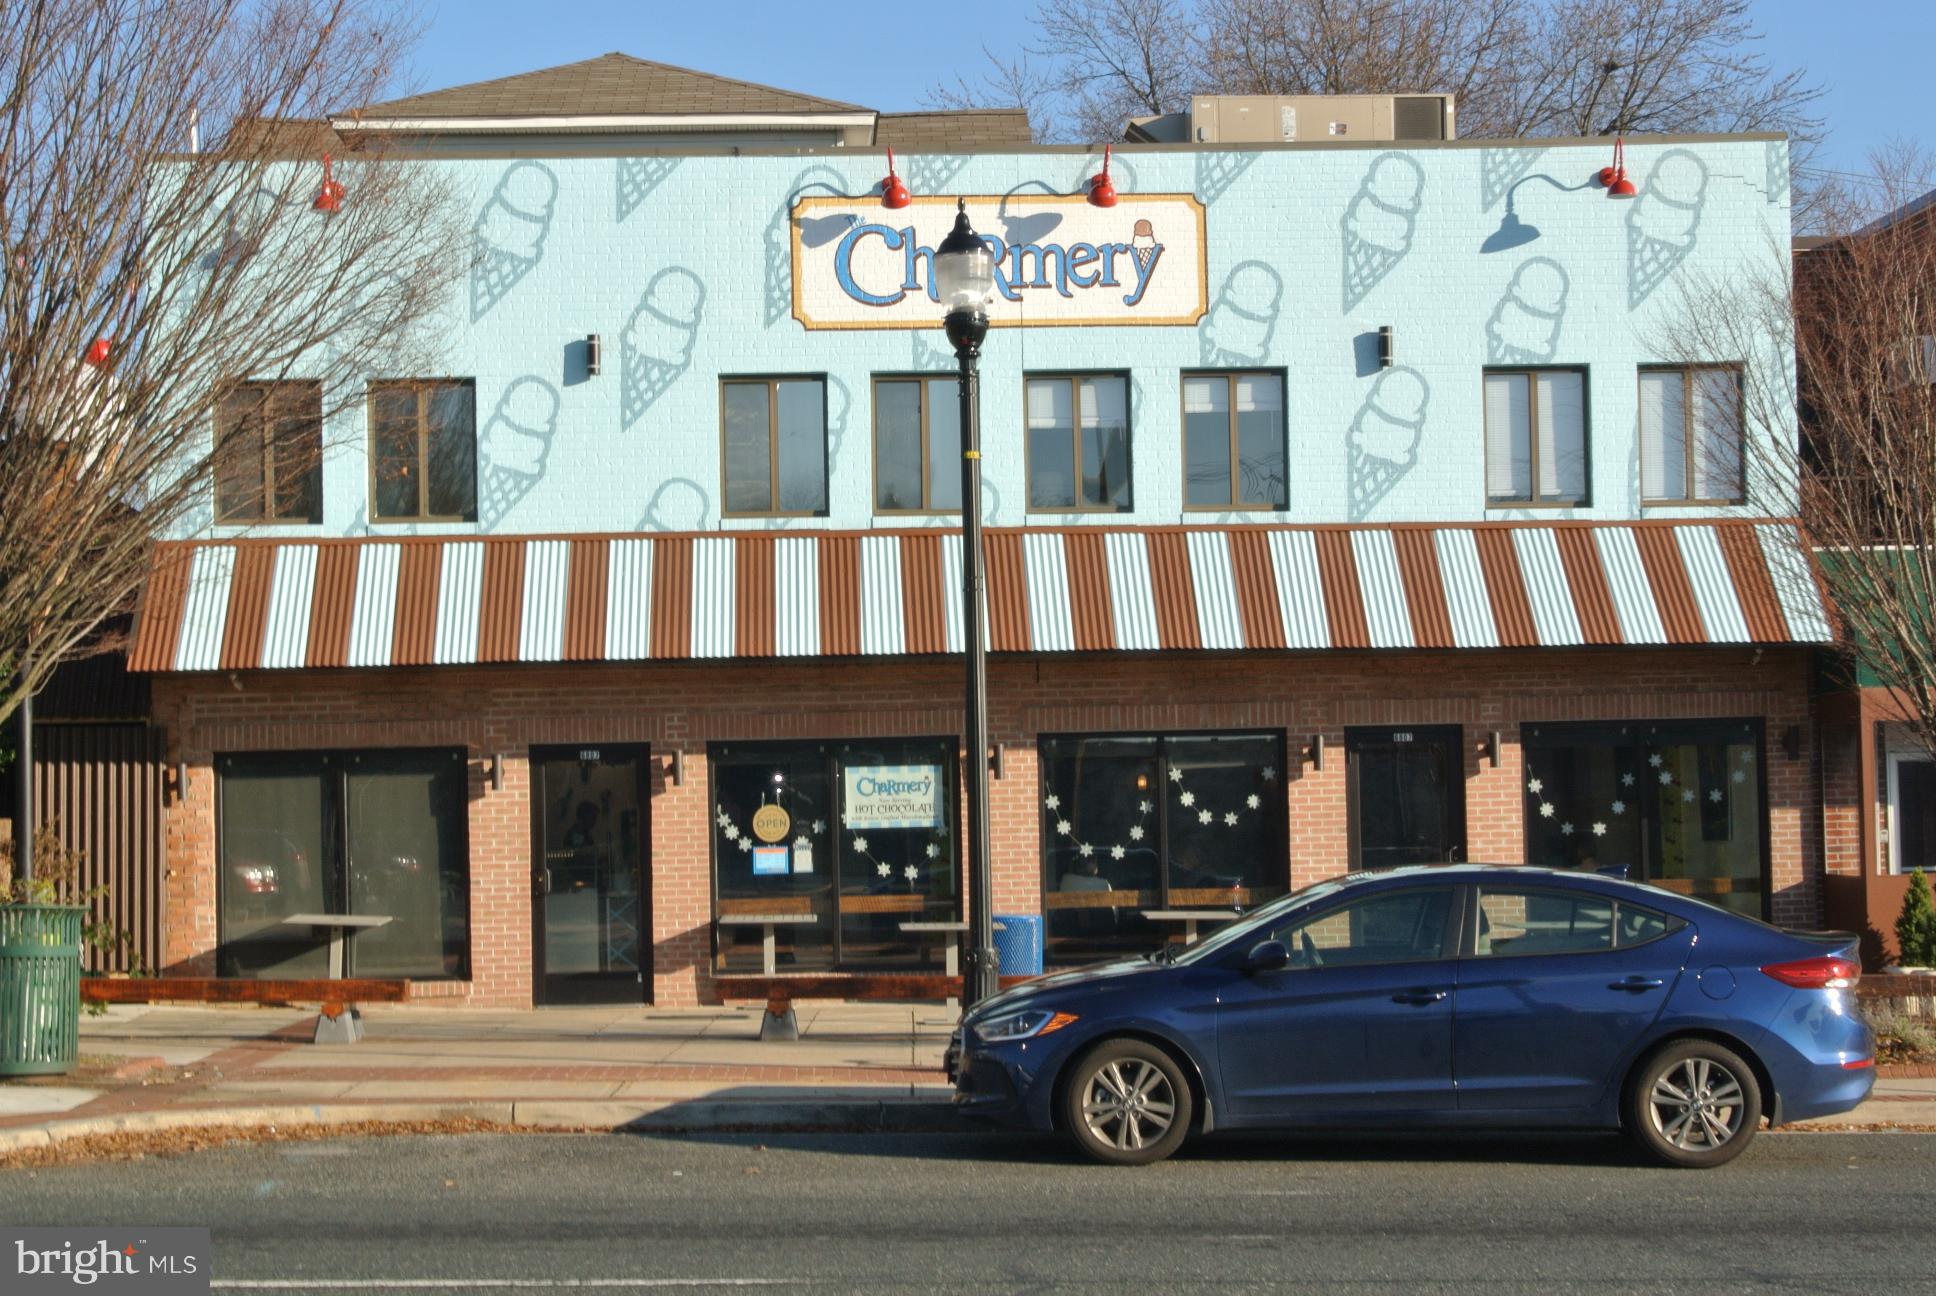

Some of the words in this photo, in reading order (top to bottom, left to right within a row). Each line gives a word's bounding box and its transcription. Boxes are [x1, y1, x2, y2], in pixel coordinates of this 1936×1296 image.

[844, 213, 867, 227] The
[834, 224, 1165, 307] ChRmery
[855, 804, 875, 816] HOT
[756, 819, 788, 829] OPEN
